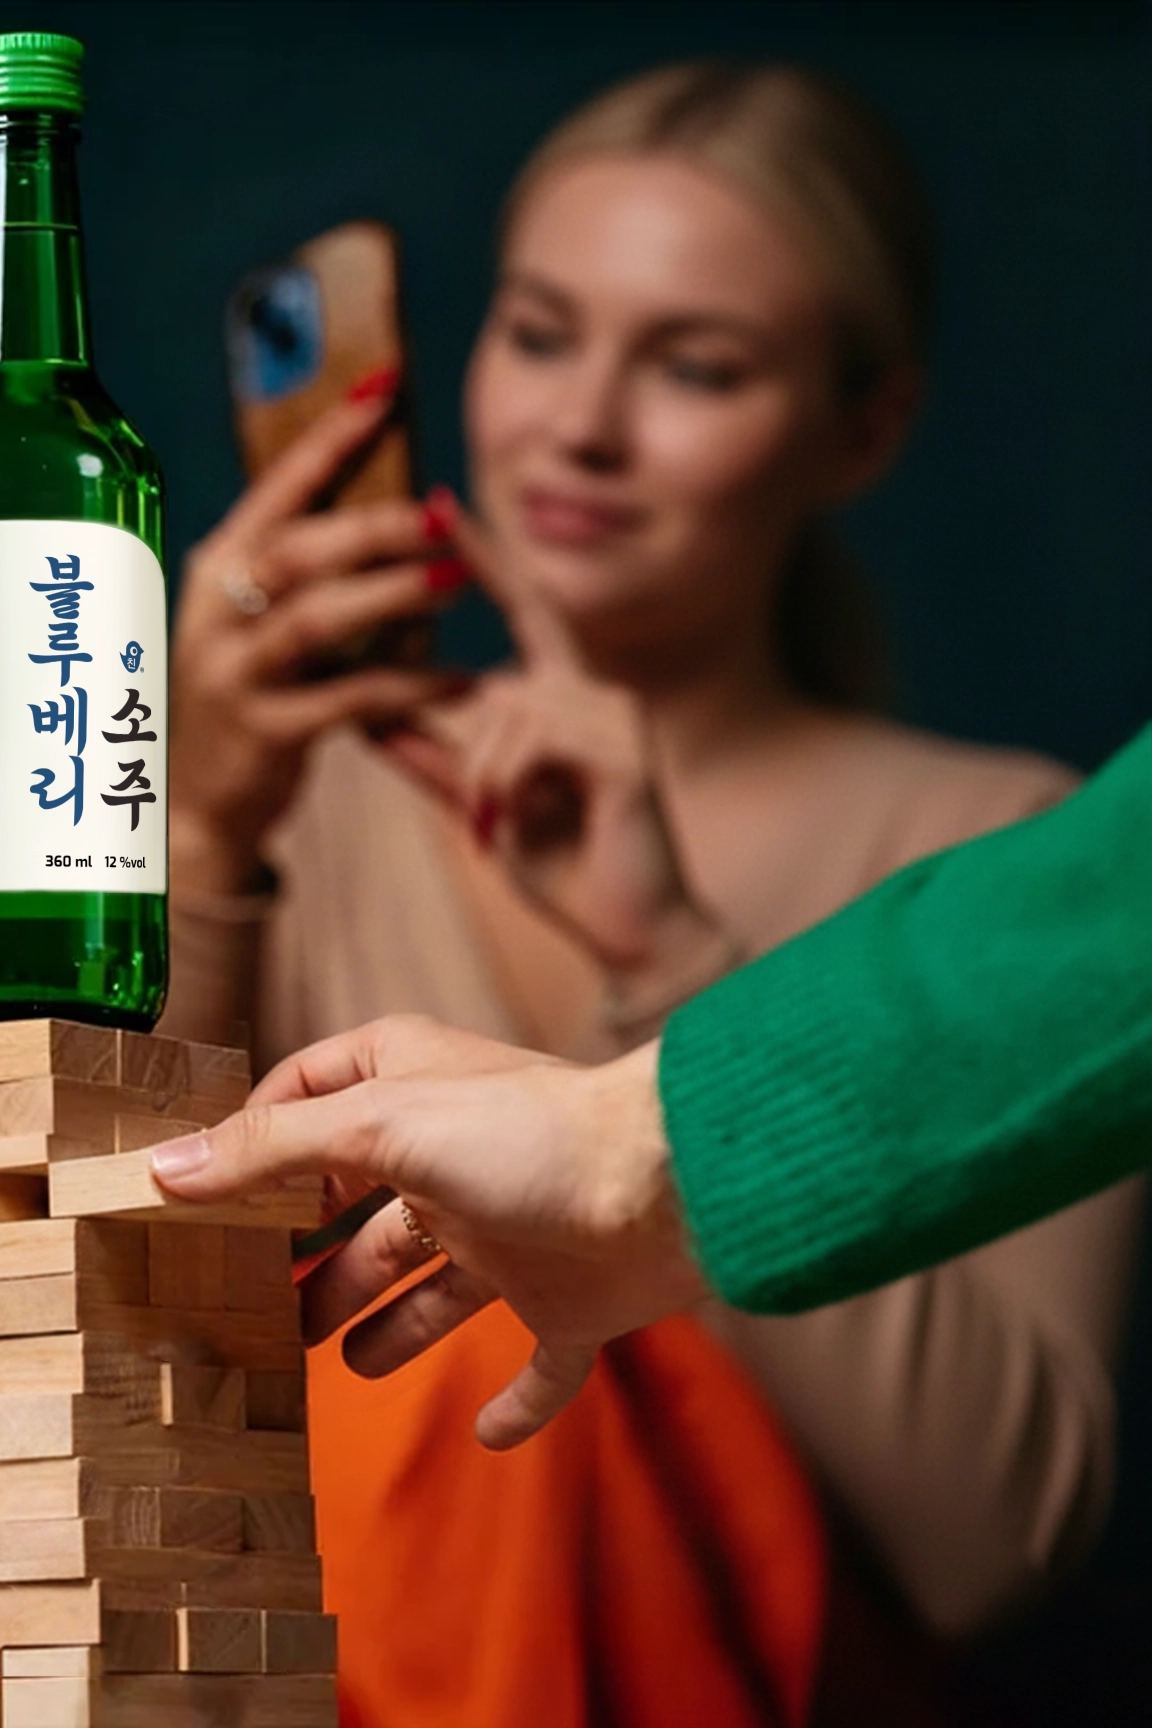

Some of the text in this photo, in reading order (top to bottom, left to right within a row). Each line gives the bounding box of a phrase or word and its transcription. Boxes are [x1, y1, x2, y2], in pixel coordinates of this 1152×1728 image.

[27, 554, 94, 827] 블루베리
[100, 689, 157, 832] 소주
[45, 855, 71, 867] 360
[75, 855, 93, 868] ml
[104, 856, 117, 868] 12
